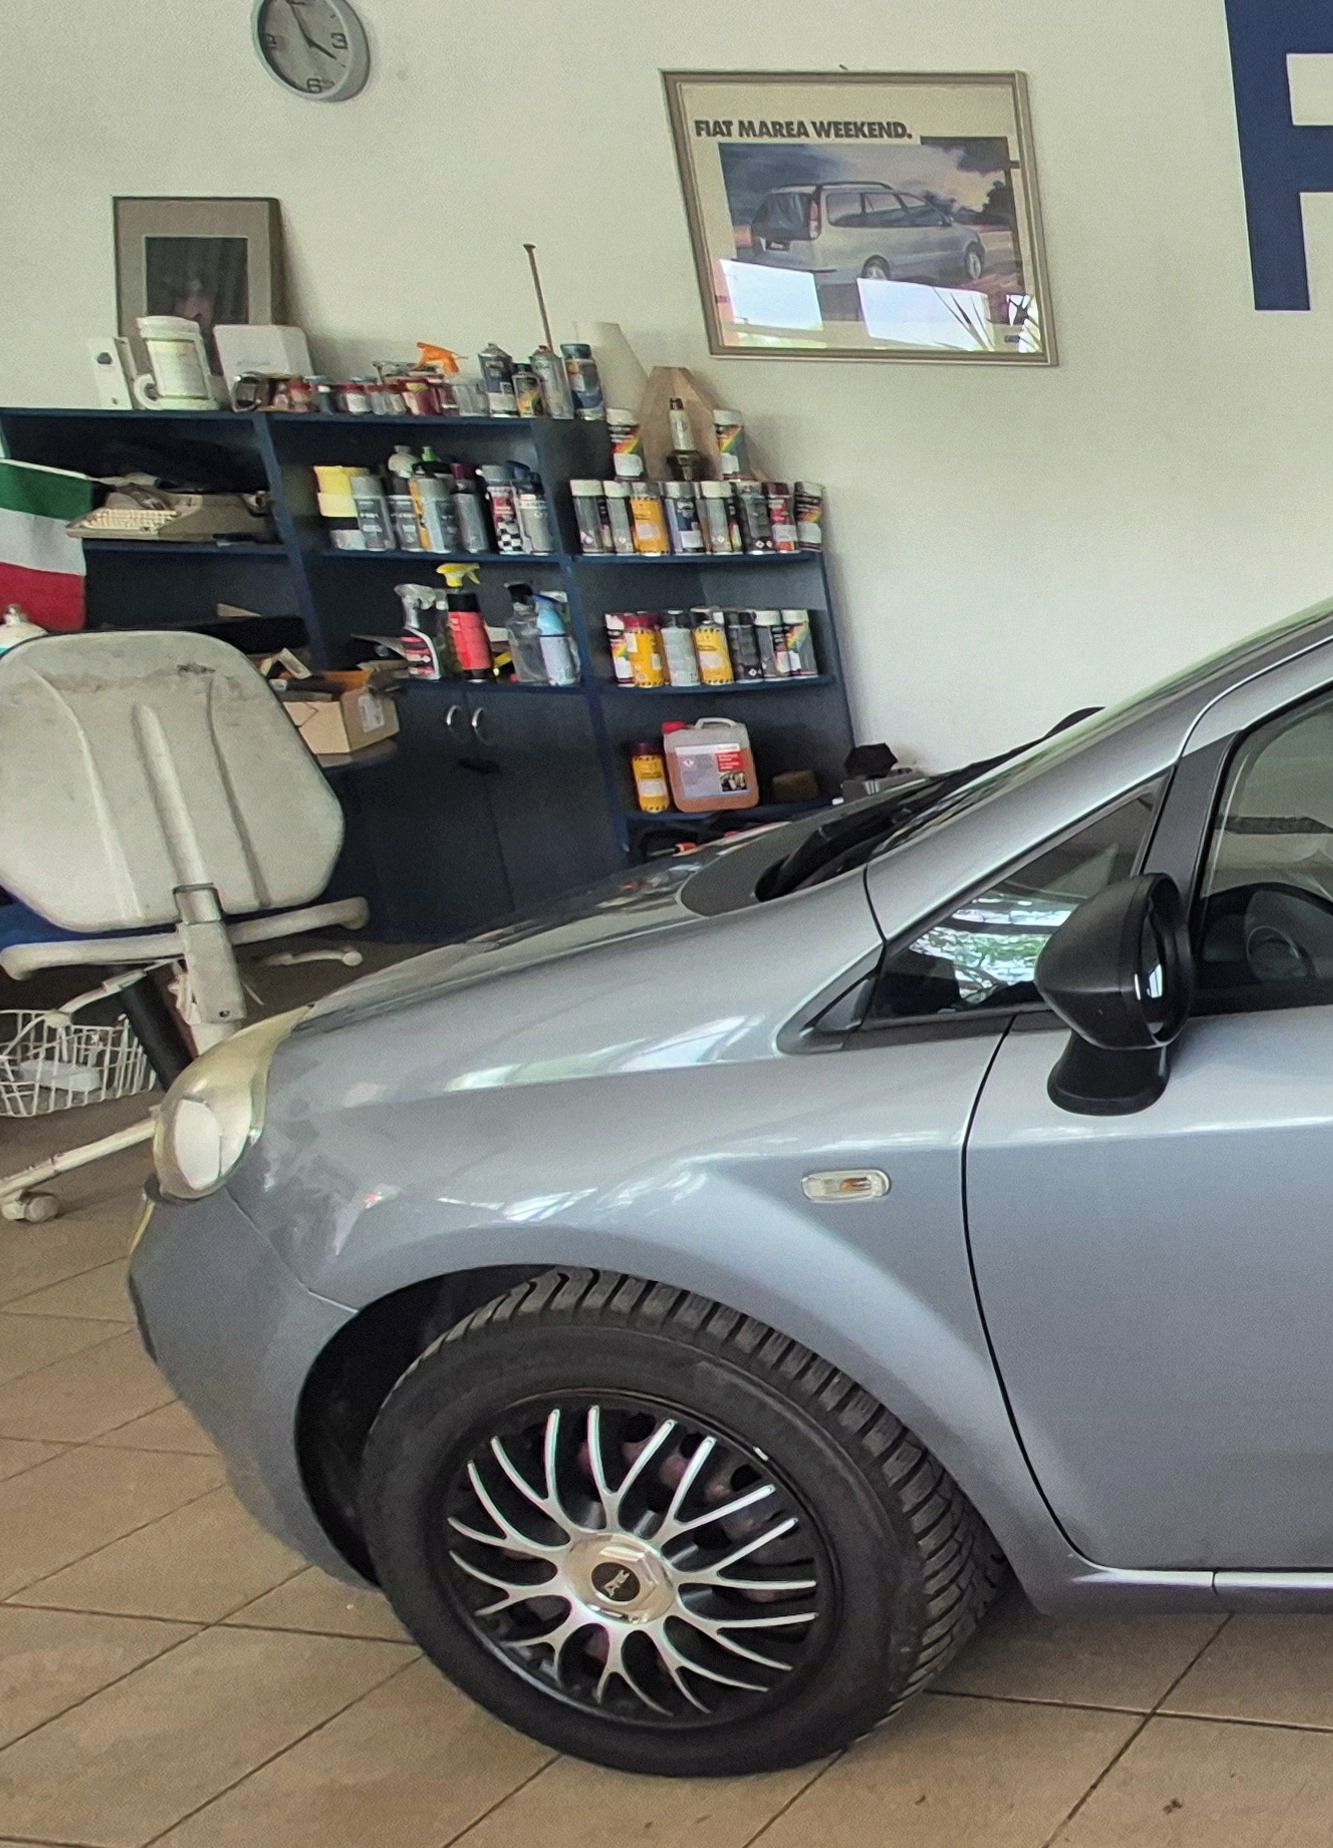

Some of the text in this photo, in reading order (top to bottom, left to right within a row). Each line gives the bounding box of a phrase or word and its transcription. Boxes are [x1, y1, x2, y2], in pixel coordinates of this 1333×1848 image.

[695, 119, 913, 139] FIAT MAREA WEEKEND.
